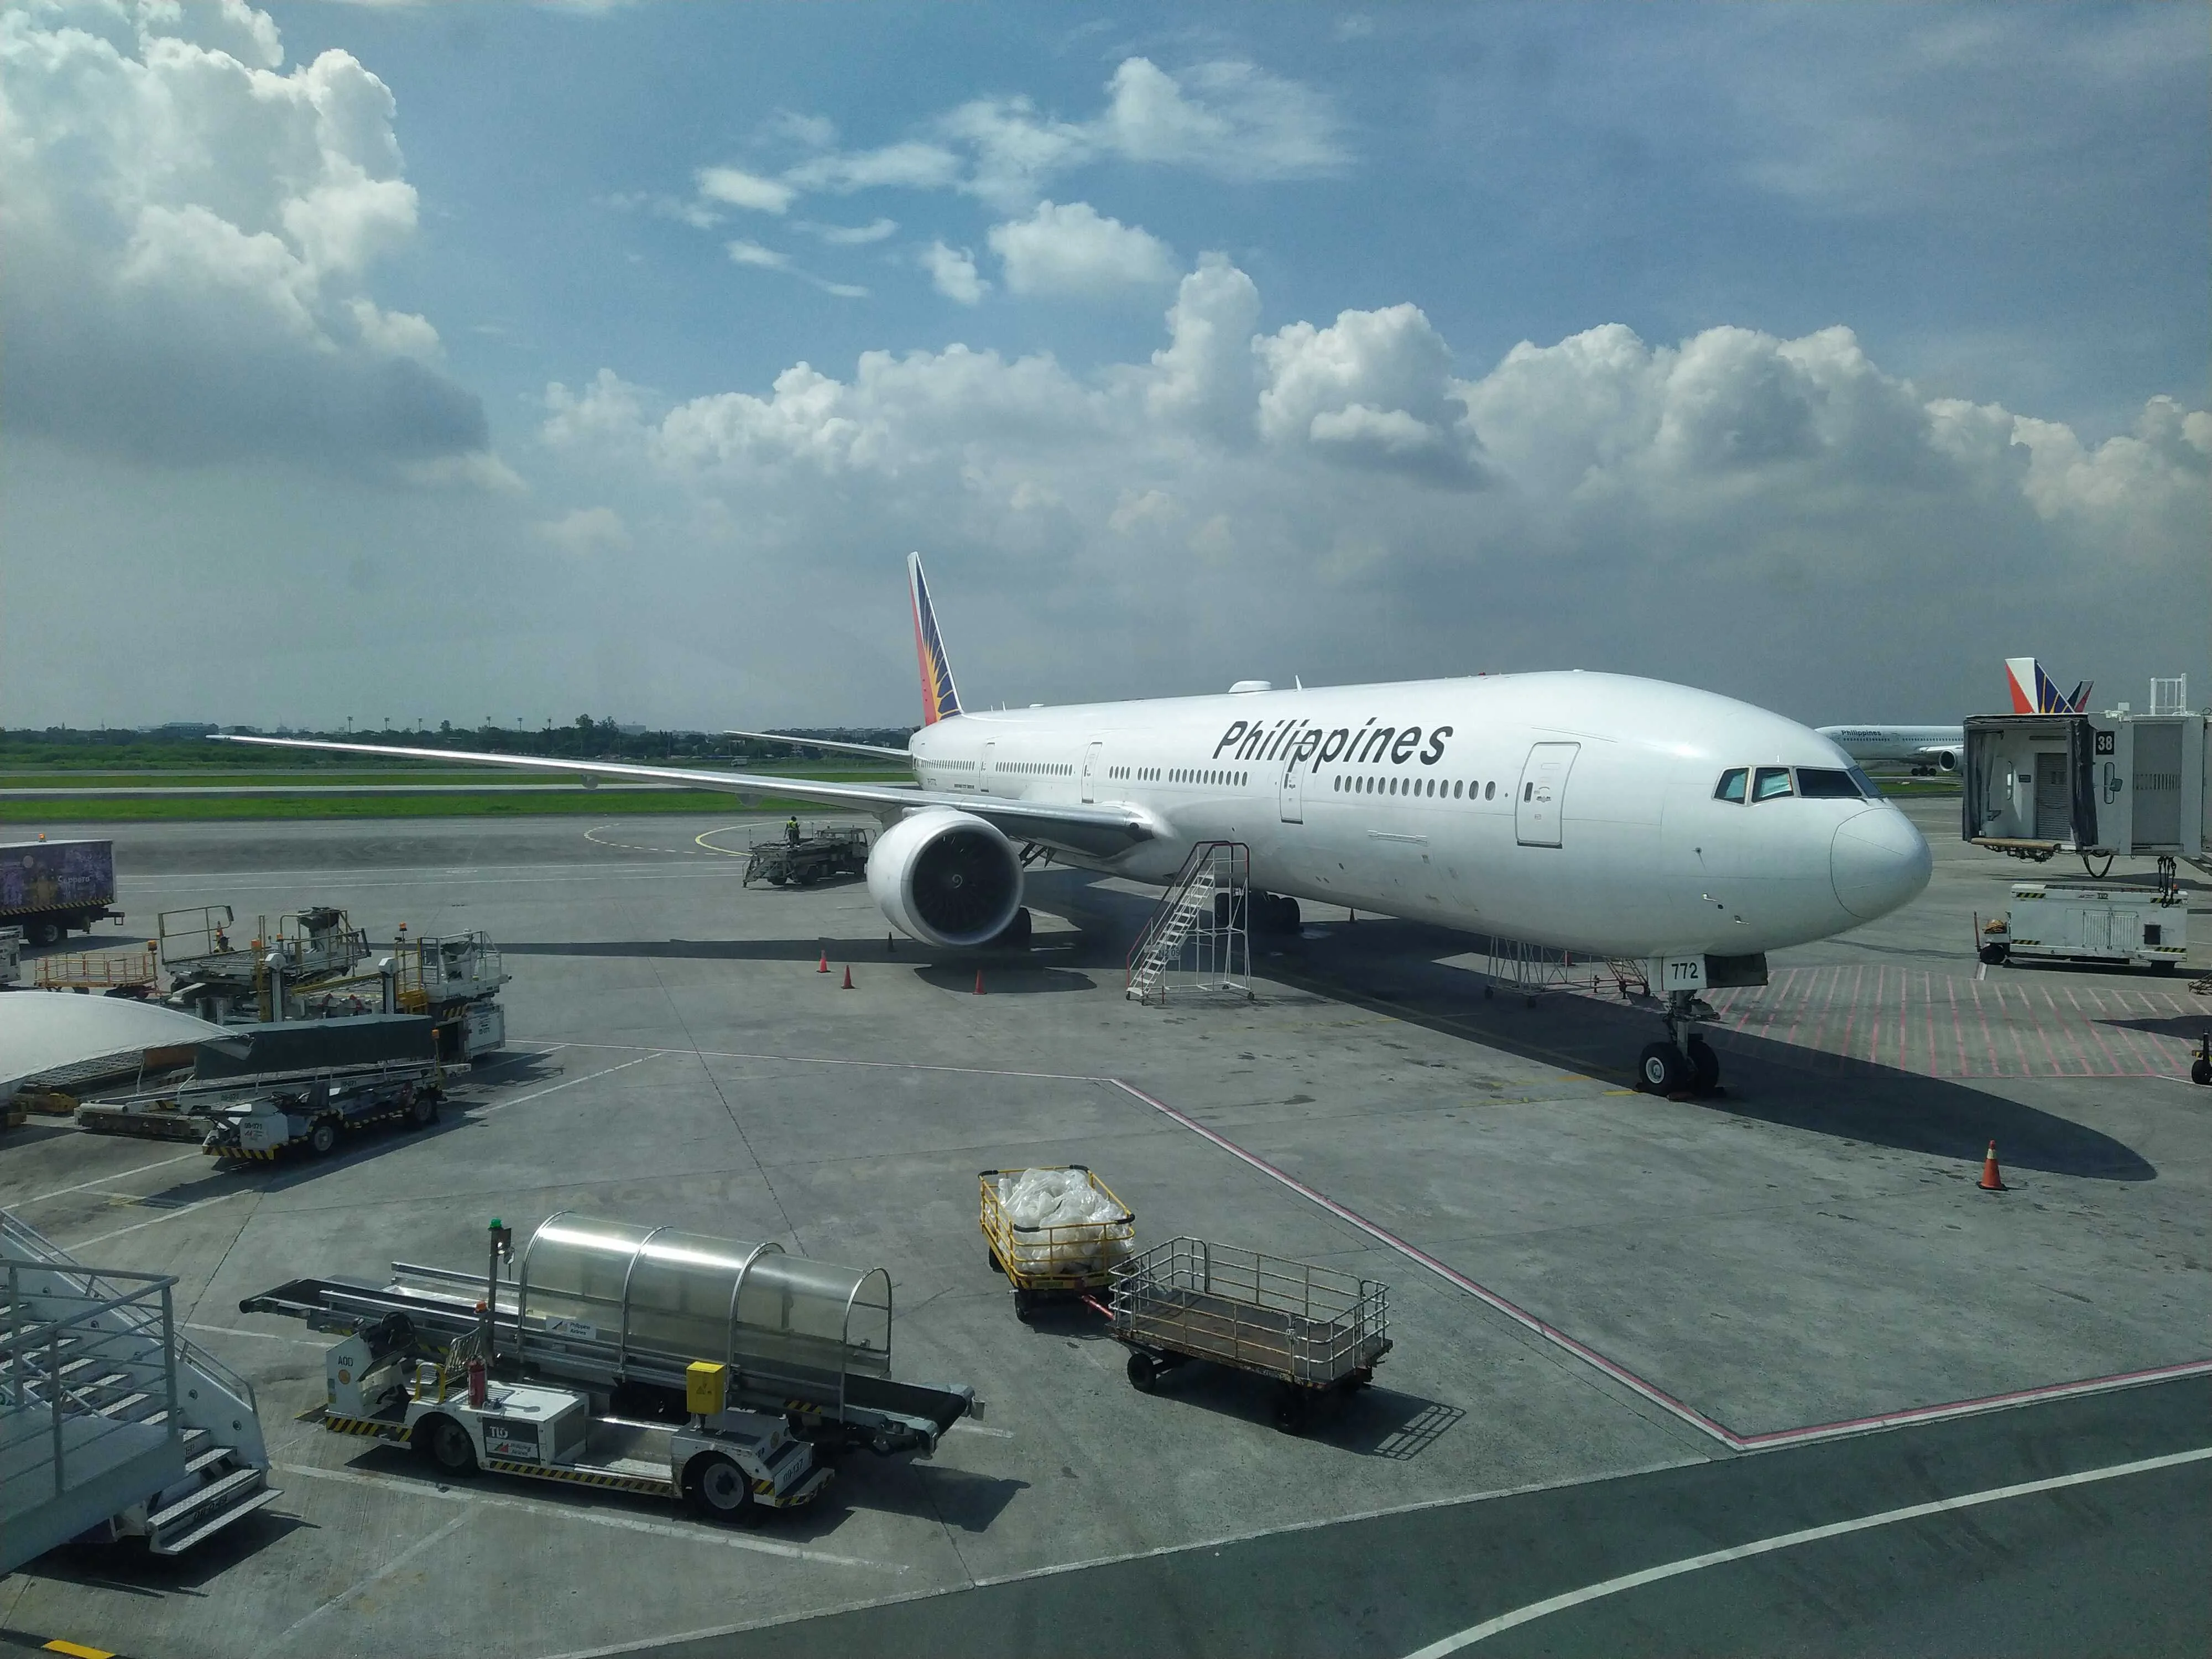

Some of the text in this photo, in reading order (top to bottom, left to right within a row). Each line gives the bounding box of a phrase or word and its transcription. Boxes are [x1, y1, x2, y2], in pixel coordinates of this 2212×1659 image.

[1212, 717, 1454, 774] Philippines
[2098, 735, 2112, 751] 38
[1672, 962, 1699, 979] 772
